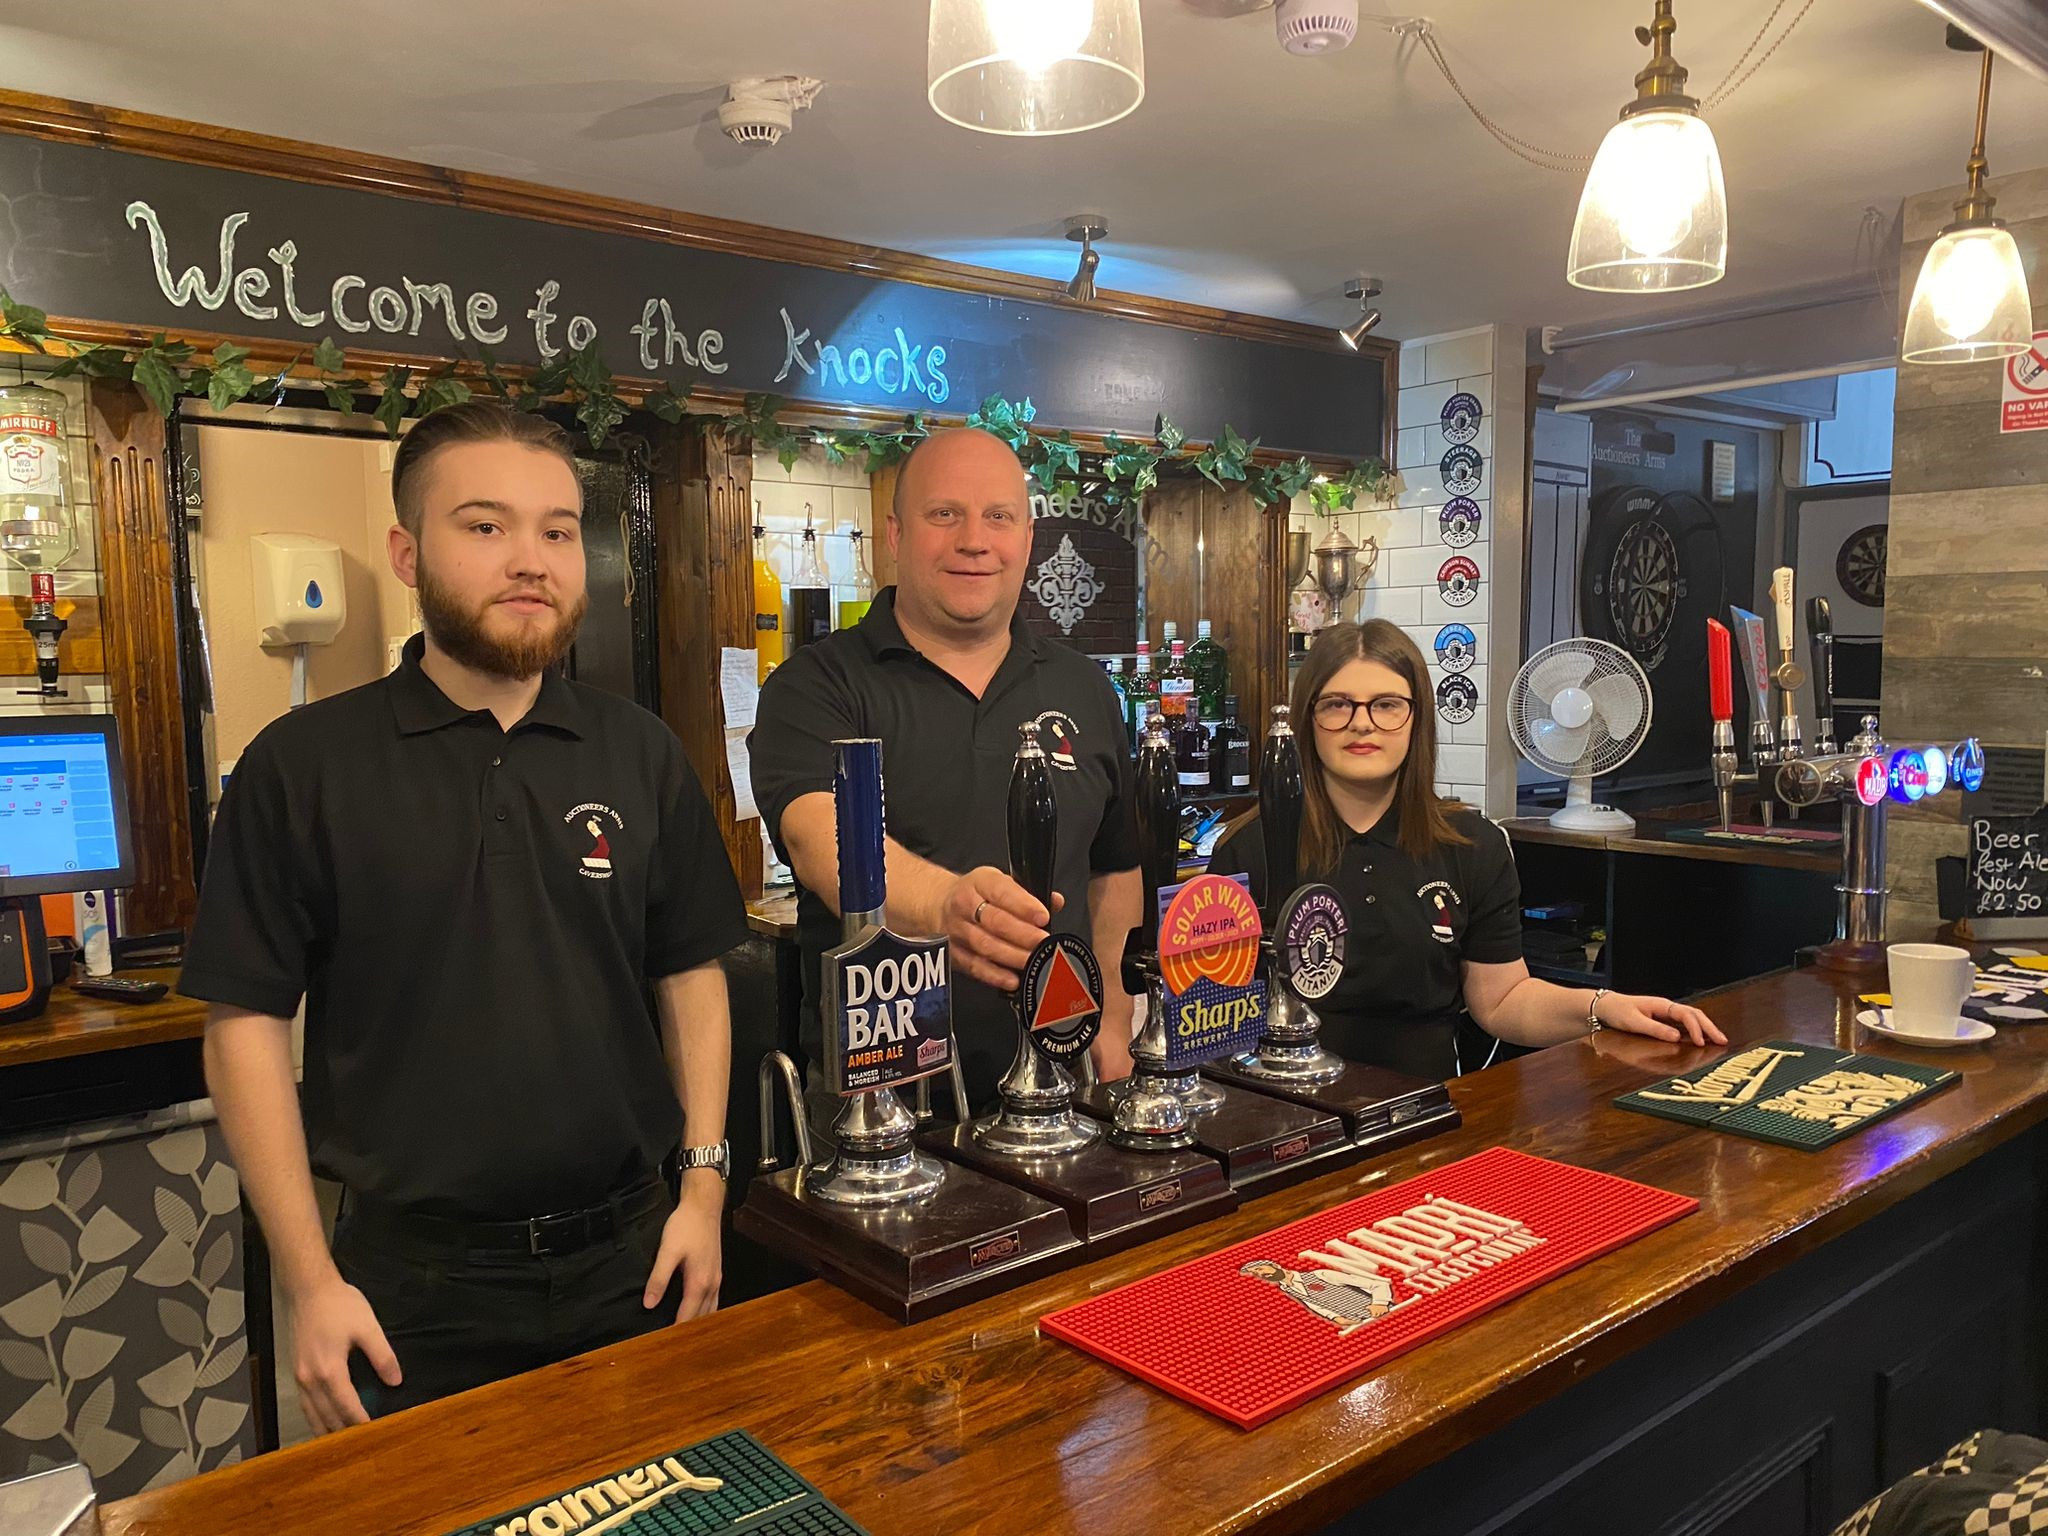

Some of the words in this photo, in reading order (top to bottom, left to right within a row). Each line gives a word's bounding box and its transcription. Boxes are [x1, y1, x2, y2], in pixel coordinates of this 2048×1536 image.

[126, 201, 508, 344] Welcome
[528, 280, 597, 361] to
[631, 298, 729, 374] the
[2008, 403, 2025, 413] NO
[1447, 429, 1473, 441] TITANIC
[1625, 428, 1642, 448] The
[1445, 447, 1478, 463] STEERAGE
[1592, 444, 1640, 466] Auctioneers
[1644, 451, 1666, 470] Arms
[1449, 480, 1476, 492] TITANIC
[1442, 500, 1457, 519] PLUM
[1458, 499, 1480, 518] PORTER
[1446, 534, 1473, 544] TITANIC
[1445, 592, 1472, 602] TITANIC
[1444, 657, 1470, 669] TITANIC
[1441, 676, 1462, 690] BLACK
[1463, 679, 1474, 692] ICE
[1443, 708, 1469, 720] TITANIC
[564, 803, 609, 823] AUCTIONEERS
[609, 810, 624, 830] ARMS
[1974, 820, 2039, 852] Beer
[1977, 891, 2042, 914] £2.50
[1173, 886, 1214, 946] SOLAR
[1218, 884, 1255, 932] WAVE
[1288, 900, 1310, 939] PLUM
[1312, 896, 1345, 929] PORTER
[1192, 920, 1218, 937] HAZY
[1220, 917, 1235, 931] IPA
[1064, 940, 1084, 958] BREWED
[845, 947, 946, 1007] DOOM
[1032, 960, 1041, 976] BASS
[1297, 965, 1337, 990] TITANIC
[1178, 991, 1261, 1037] Sharp's
[847, 999, 919, 1051] BAR
[1042, 1037, 1080, 1054] PREMIUM
[1080, 1024, 1093, 1041] ALE
[1183, 1030, 1228, 1051] BREWERY
[848, 1050, 883, 1068] AMBER
[886, 1045, 903, 1061] ALE
[848, 1069, 879, 1081] BALANCED
[854, 1075, 880, 1086] MOREISH
[1404, 1231, 1548, 1294] EXCEPCIONAL
